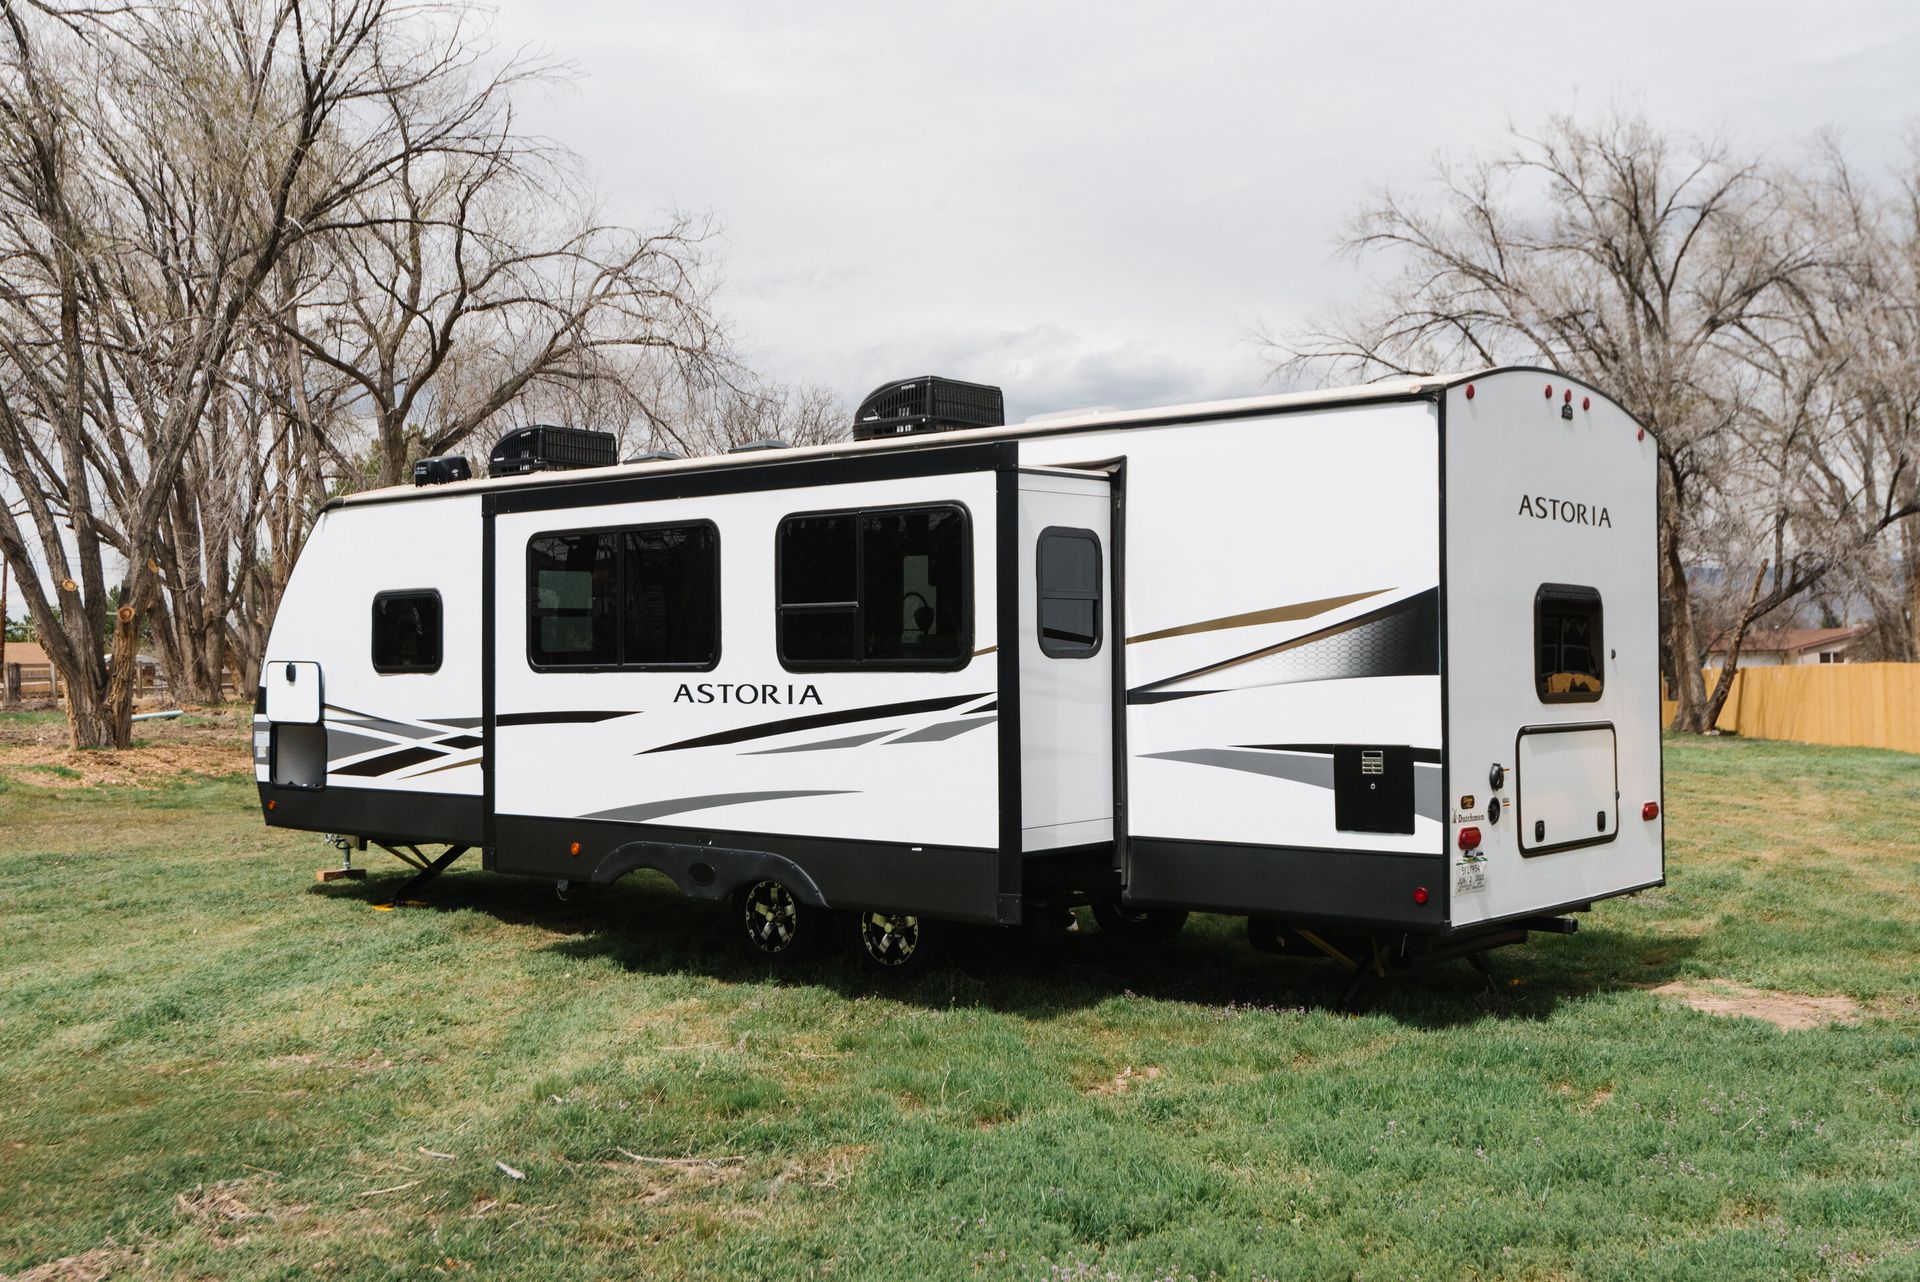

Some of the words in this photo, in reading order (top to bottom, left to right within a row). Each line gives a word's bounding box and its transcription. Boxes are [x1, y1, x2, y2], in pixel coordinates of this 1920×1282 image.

[1518, 494, 1612, 529] ASTORIA
[673, 683, 824, 705] ASTORIA
[1458, 813, 1485, 823] Dutchmen
